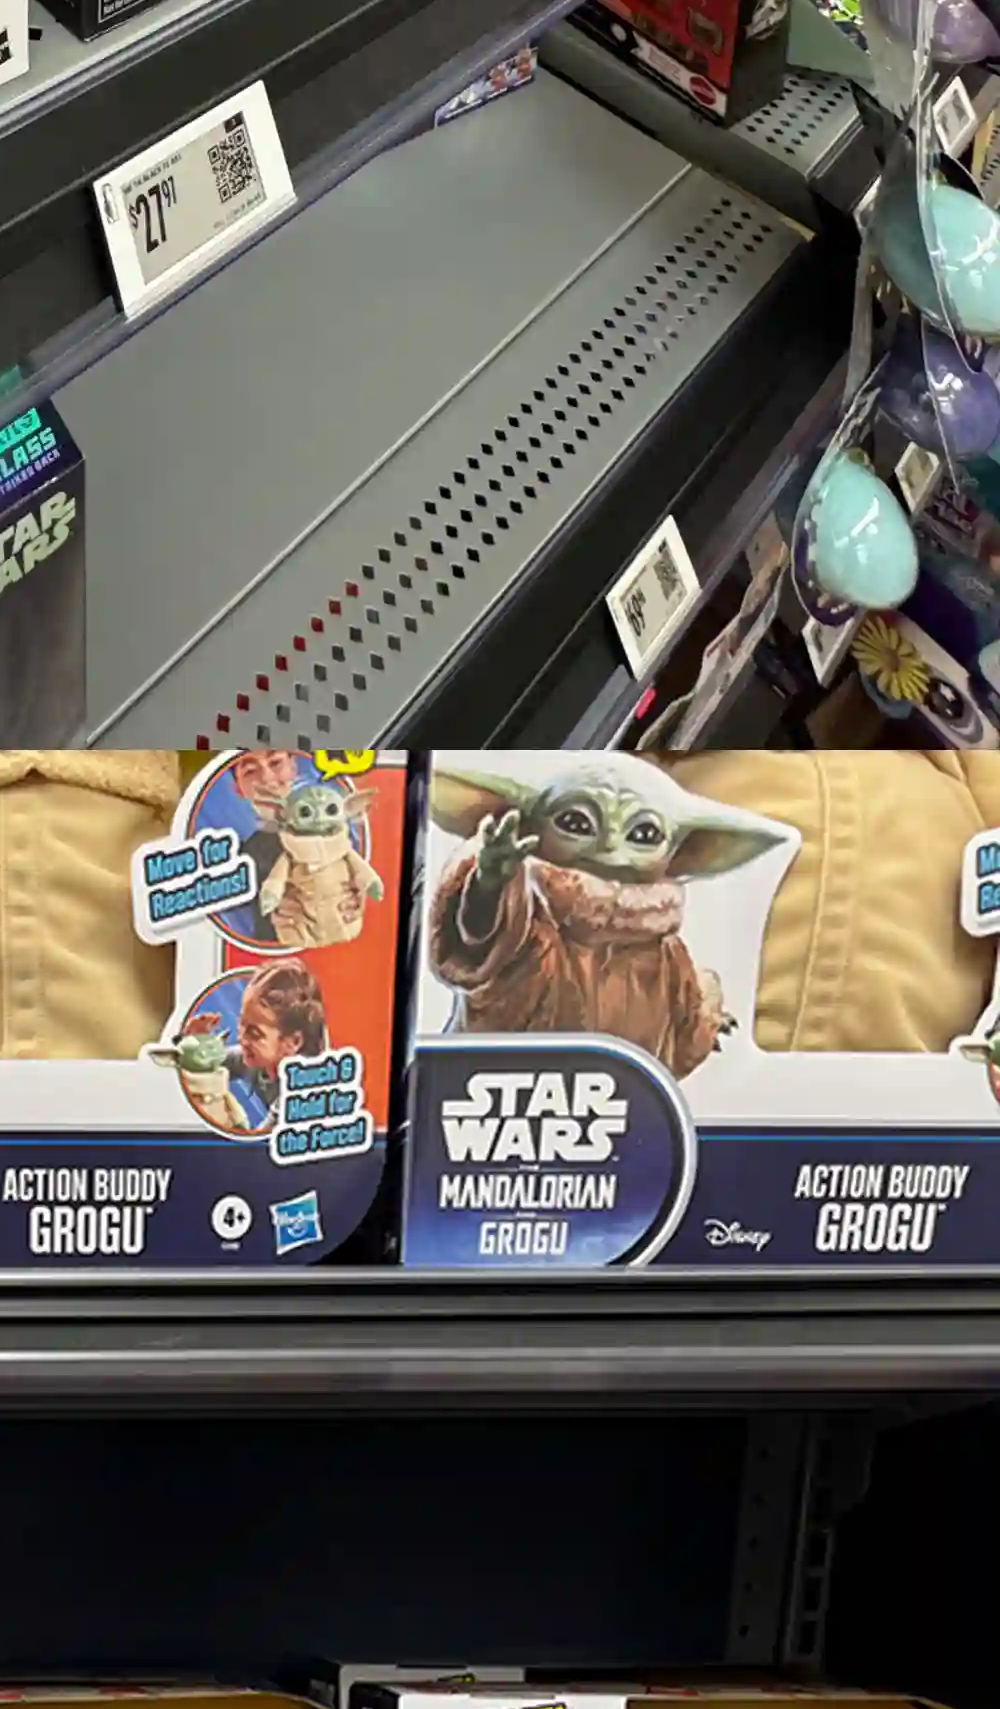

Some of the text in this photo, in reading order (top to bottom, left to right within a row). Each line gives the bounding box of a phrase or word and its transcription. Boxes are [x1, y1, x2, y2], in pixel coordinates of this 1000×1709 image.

[33, 449, 61, 472] BACK
[442, 1072, 628, 1118] STAR
[442, 1117, 628, 1163] WARS
[2, 1169, 171, 1203] ACTION BUDDY
[439, 1174, 616, 1210] MANDALORIAN
[794, 1163, 969, 1199] ACTION BUDDY
[479, 1220, 569, 1256] GROGU
